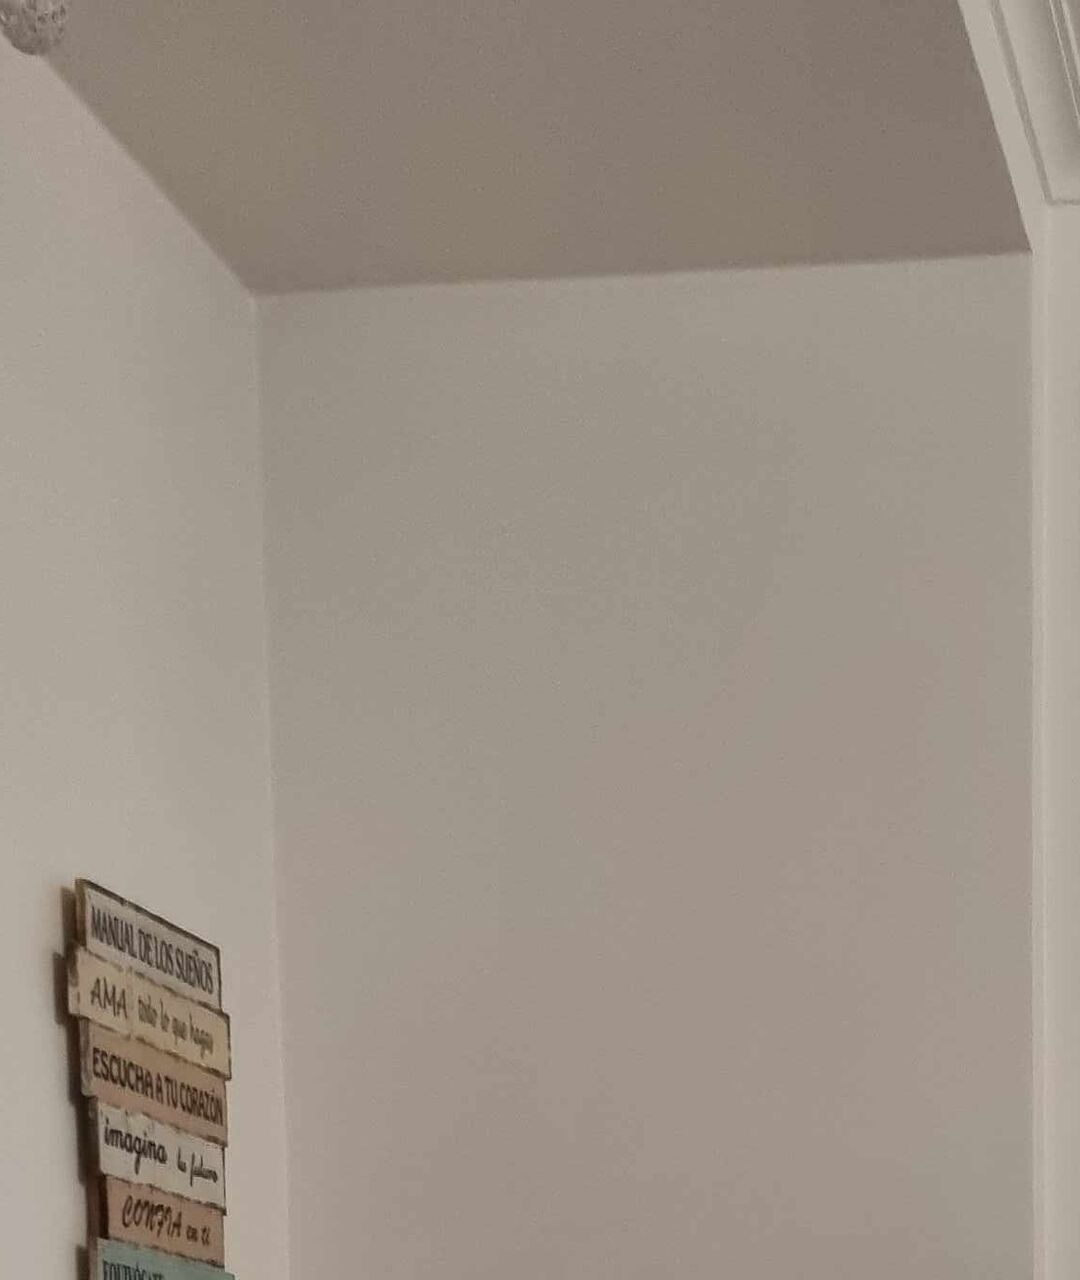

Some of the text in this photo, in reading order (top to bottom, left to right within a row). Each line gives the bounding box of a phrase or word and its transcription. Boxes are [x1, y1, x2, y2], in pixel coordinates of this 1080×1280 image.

[91, 905, 214, 995] MANUAL DE LOS SUEÑOS
[90, 976, 128, 1020] AMA
[92, 1046, 224, 1127] ESCUCHA A TU CORAZÓN
[104, 1115, 168, 1176] imagina
